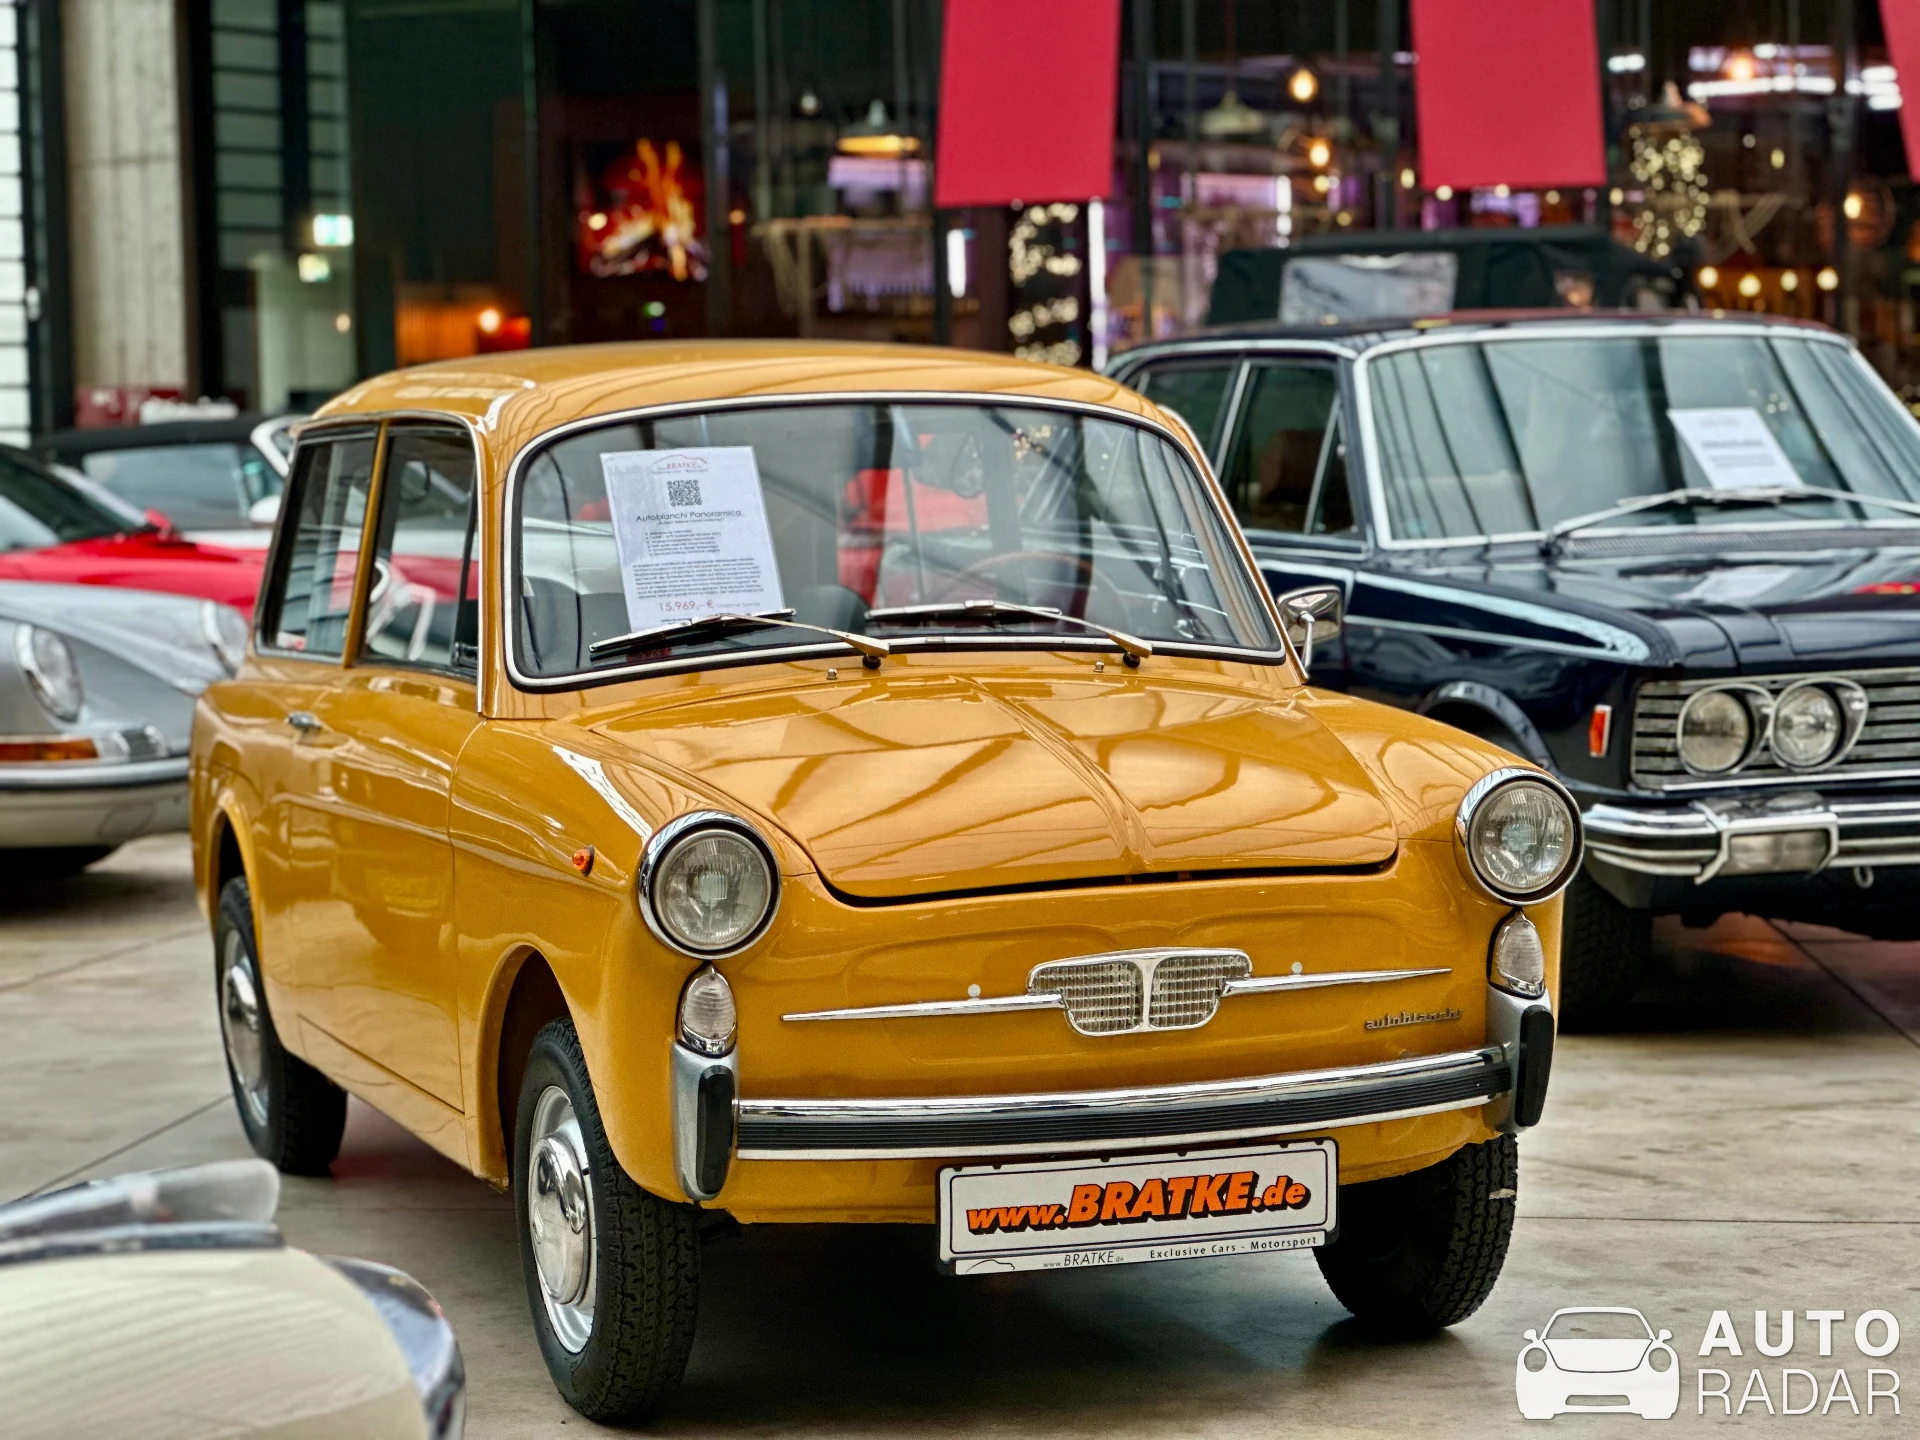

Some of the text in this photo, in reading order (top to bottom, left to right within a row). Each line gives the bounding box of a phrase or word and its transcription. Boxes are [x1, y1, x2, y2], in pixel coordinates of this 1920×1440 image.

[635, 509, 742, 522] Autobianchi Panoramica
[706, 599, 715, 609] €
[1365, 1007, 1462, 1030] autobianchi
[966, 1171, 1313, 1235] www.BRATKE.de
[1150, 1247, 1207, 1259] Exclusive
[1211, 1243, 1236, 1255] Cars
[1250, 1236, 1318, 1251] Motorsport
